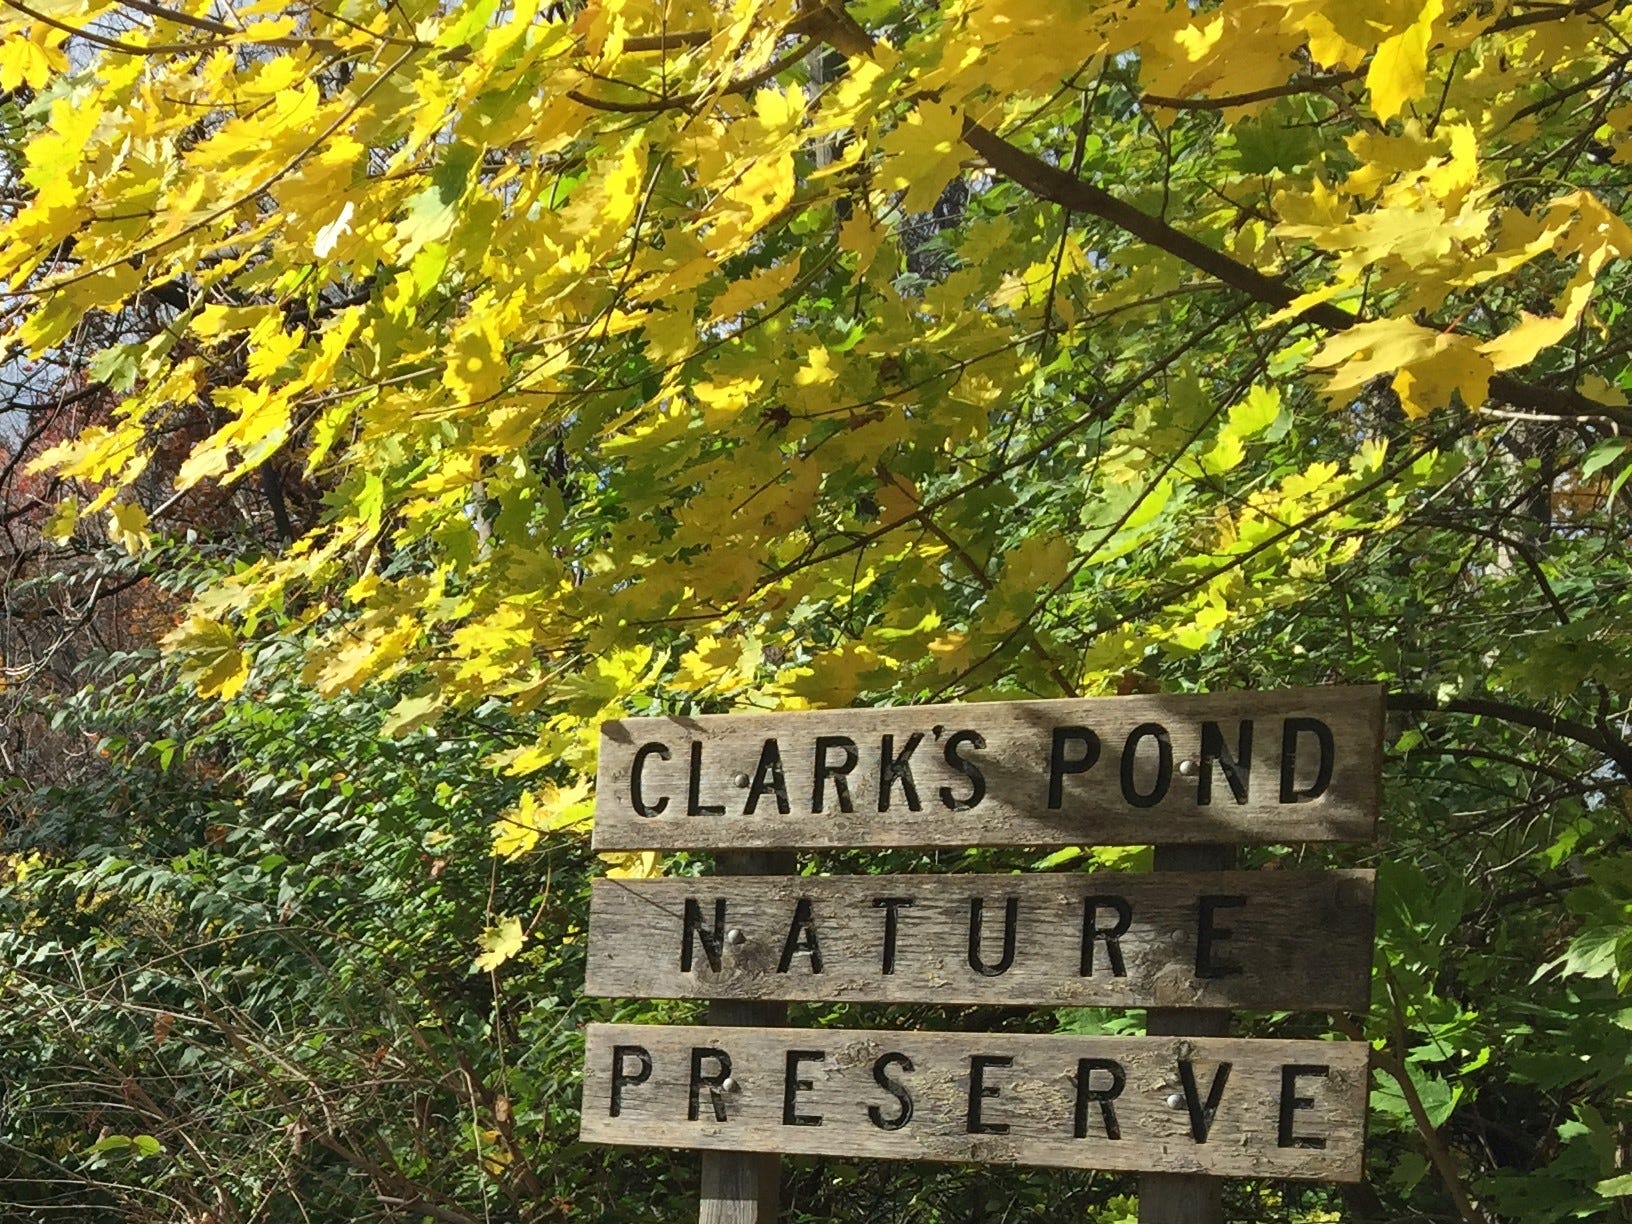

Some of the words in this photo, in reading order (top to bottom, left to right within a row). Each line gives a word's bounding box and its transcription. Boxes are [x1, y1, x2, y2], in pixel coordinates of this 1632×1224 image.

[629, 724, 987, 818] CLARK'S
[1047, 717, 1335, 810] POND
[680, 895, 1247, 979] NATURE
[609, 1044, 1330, 1149] PRESERVE
